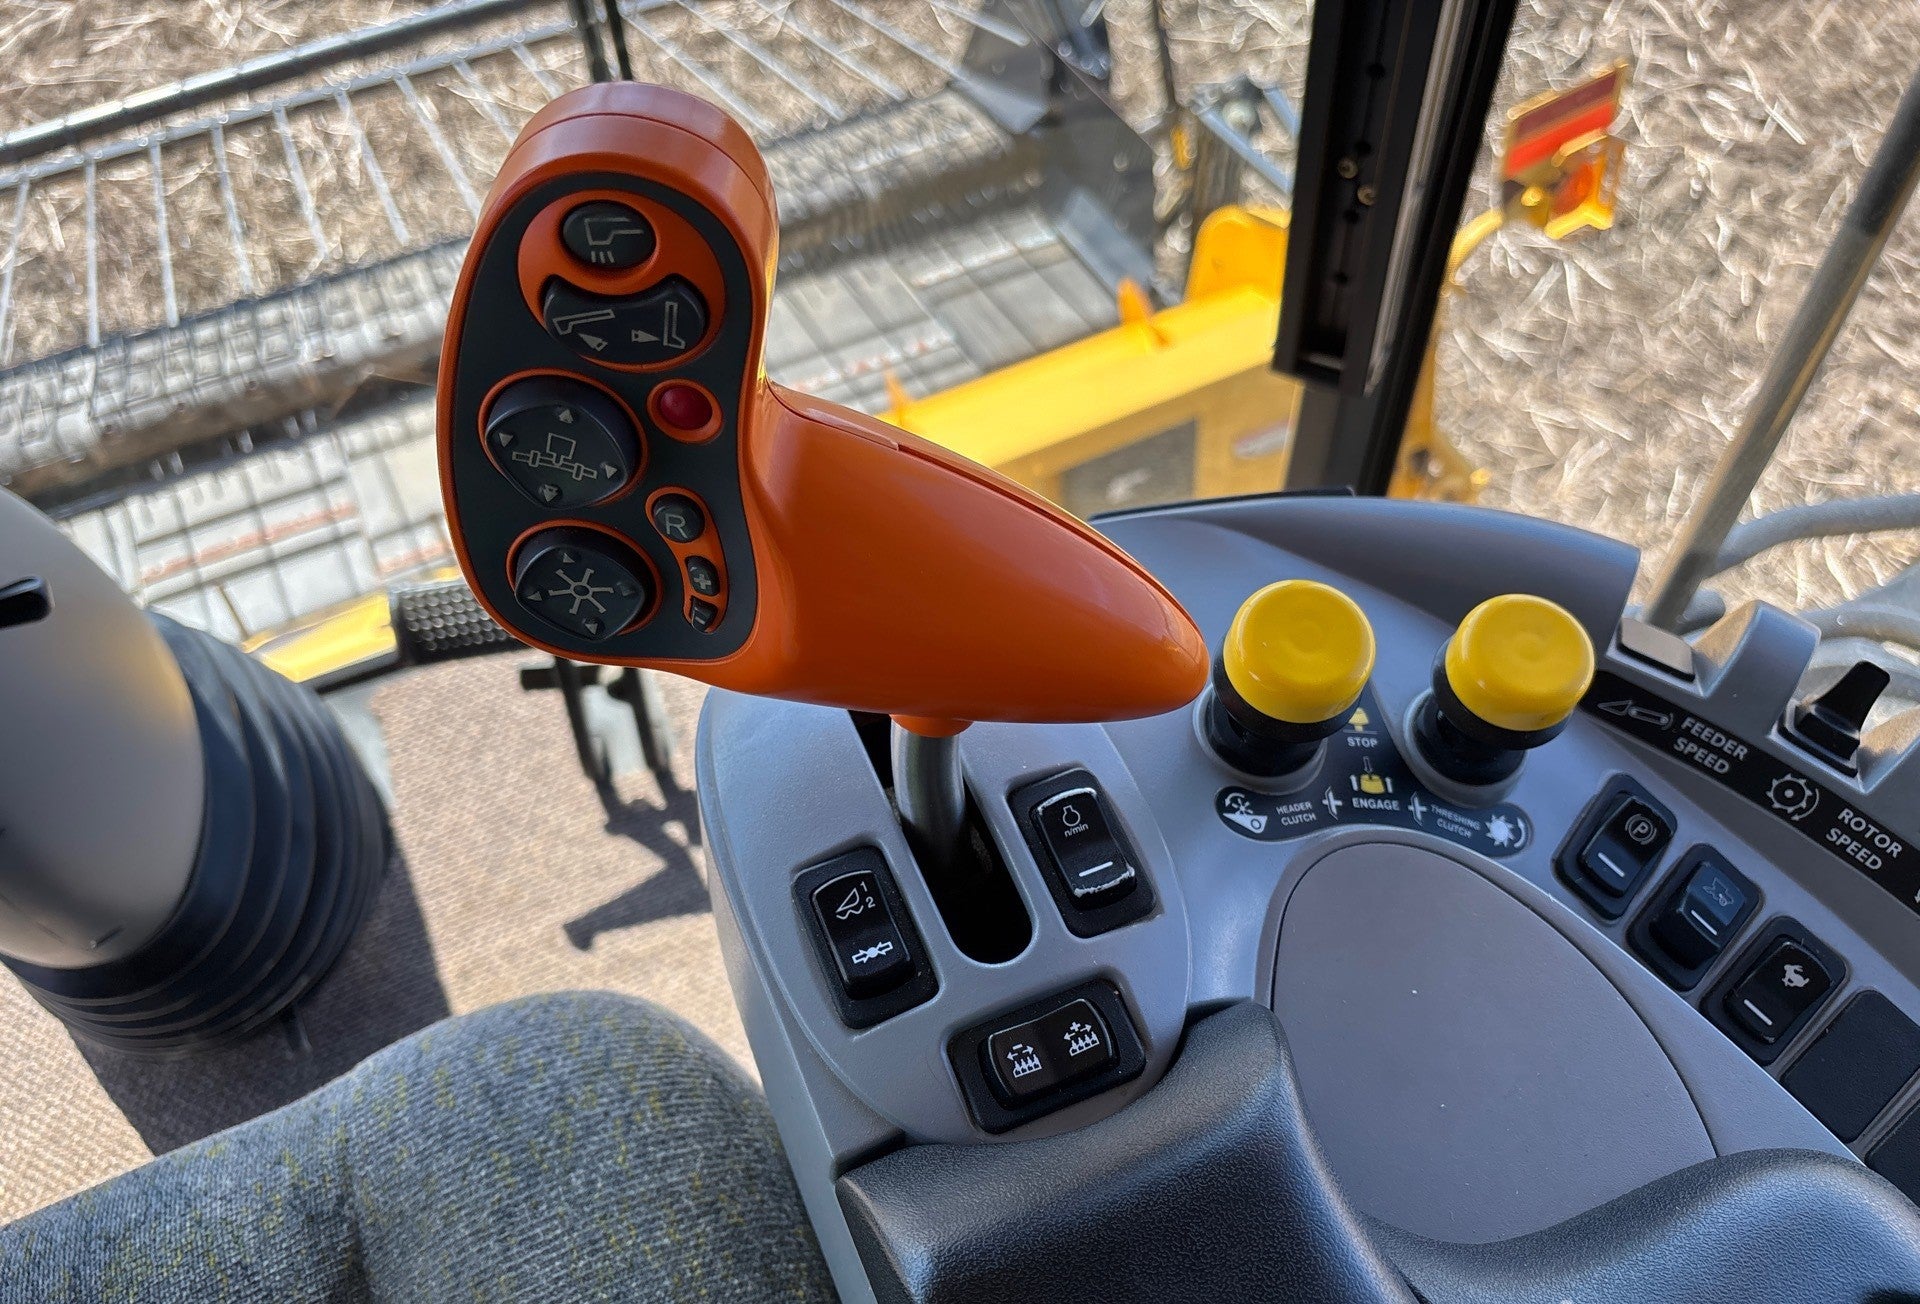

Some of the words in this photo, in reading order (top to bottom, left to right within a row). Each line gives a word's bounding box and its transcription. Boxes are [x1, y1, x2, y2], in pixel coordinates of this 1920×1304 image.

[666, 513, 687, 539] R
[1347, 737, 1378, 749] STOP
[1681, 717, 1748, 761] FEEDER
[1673, 737, 1730, 775] SPEED
[1276, 801, 1312, 815] HEADER
[1352, 797, 1400, 811] ENGAGE
[1281, 812, 1316, 826] CLUTCH
[1431, 804, 1481, 831] THRESHING
[1063, 822, 1089, 837] n/min
[1436, 818, 1472, 839] CLUTCH
[1633, 821, 1648, 836] P
[1838, 808, 1903, 859] ROTOR
[1825, 827, 1883, 872] SPEED
[860, 881, 868, 893] 1
[865, 897, 876, 908] 2
